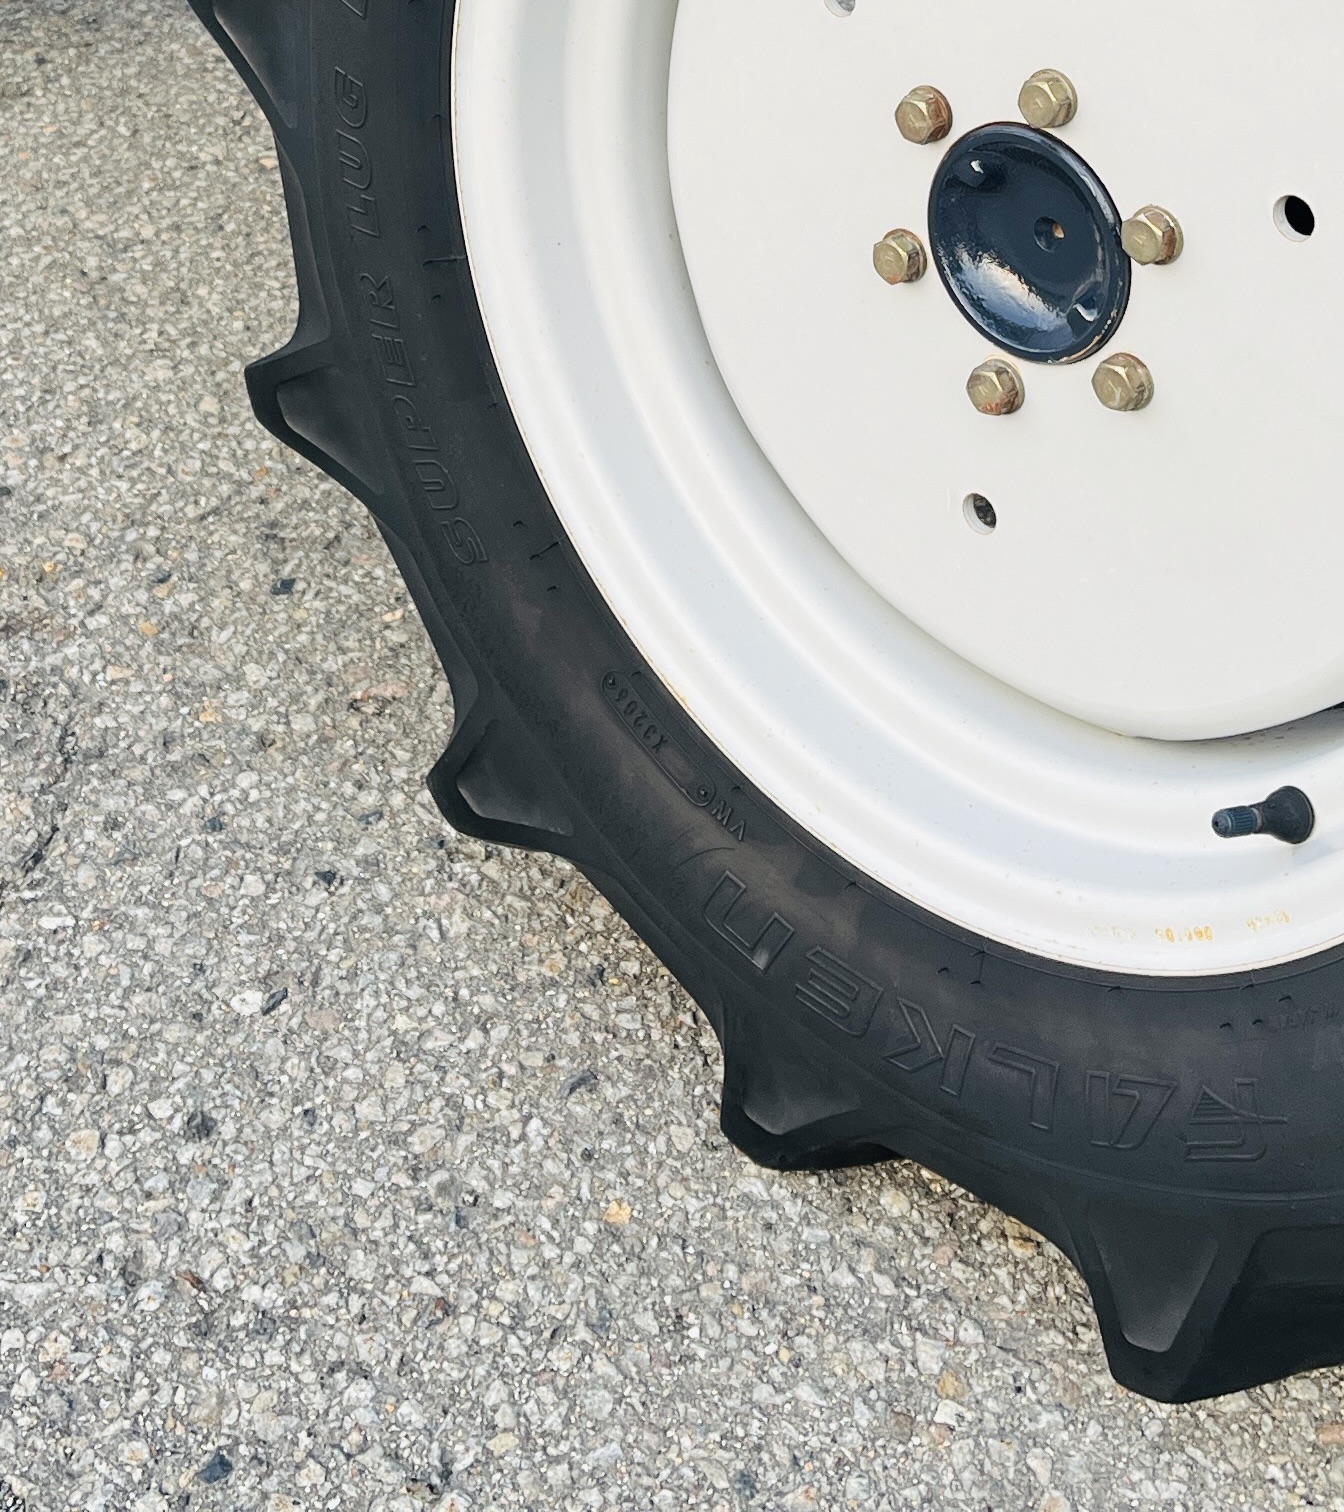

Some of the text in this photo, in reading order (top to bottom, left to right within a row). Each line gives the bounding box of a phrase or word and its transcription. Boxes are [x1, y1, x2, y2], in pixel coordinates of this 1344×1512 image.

[334, 66, 384, 240] LUG
[362, 273, 488, 570] SUPER
[699, 867, 1288, 1165] FALKEN
